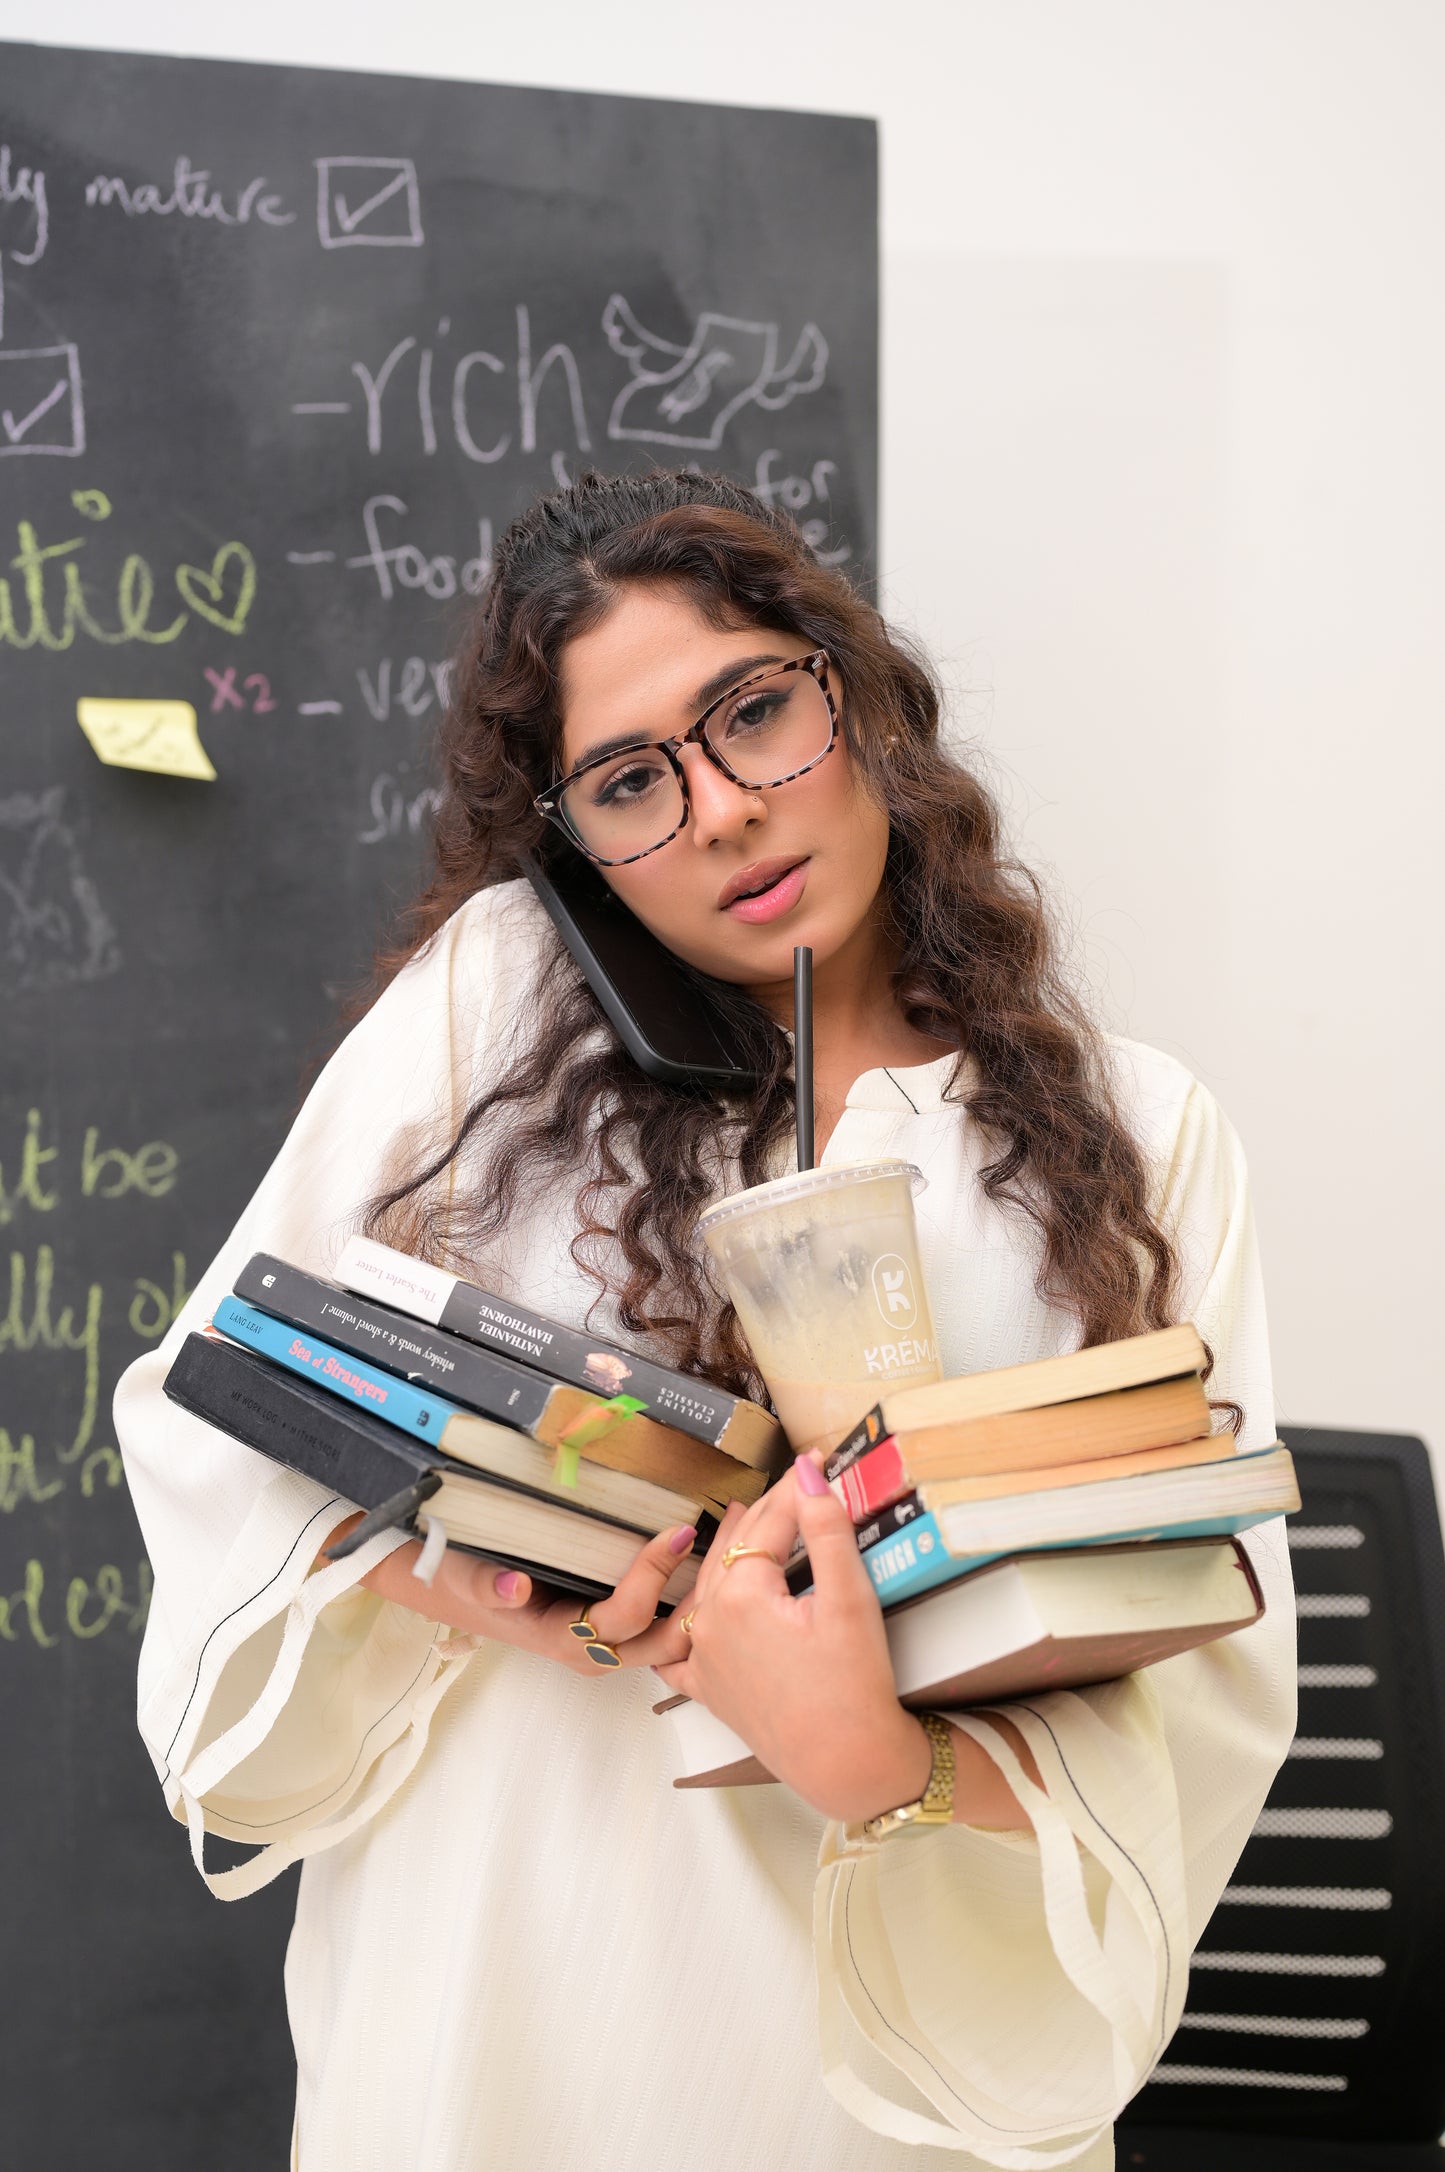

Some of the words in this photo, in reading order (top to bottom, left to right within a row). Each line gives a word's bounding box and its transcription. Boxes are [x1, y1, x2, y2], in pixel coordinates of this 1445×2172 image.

[0, 143, 49, 266] ly
[85, 156, 297, 226] mature
[345, 494, 494, 600] food
[355, 656, 456, 721] ver
[81, 1126, 179, 1199] be
[354, 1259, 385, 1280] Letter
[385, 1271, 420, 1294] Scarlet
[419, 1284, 437, 1304] The
[229, 1311, 246, 1327] LANG
[246, 1320, 264, 1335] LEAV
[328, 1306, 357, 1325] volume
[479, 1305, 554, 1346] HAWTHORNE
[354, 1319, 383, 1339] shovel
[387, 1332, 398, 1346] &
[478, 1320, 544, 1357] NATHANIEL
[397, 1337, 423, 1356] words
[288, 1339, 311, 1363] Sea
[311, 1355, 322, 1369] of
[322, 1356, 389, 1404] Strangers
[421, 1349, 456, 1373] whiskey
[656, 1396, 712, 1425] COLLINS
[659, 1386, 716, 1416] CLASSICS
